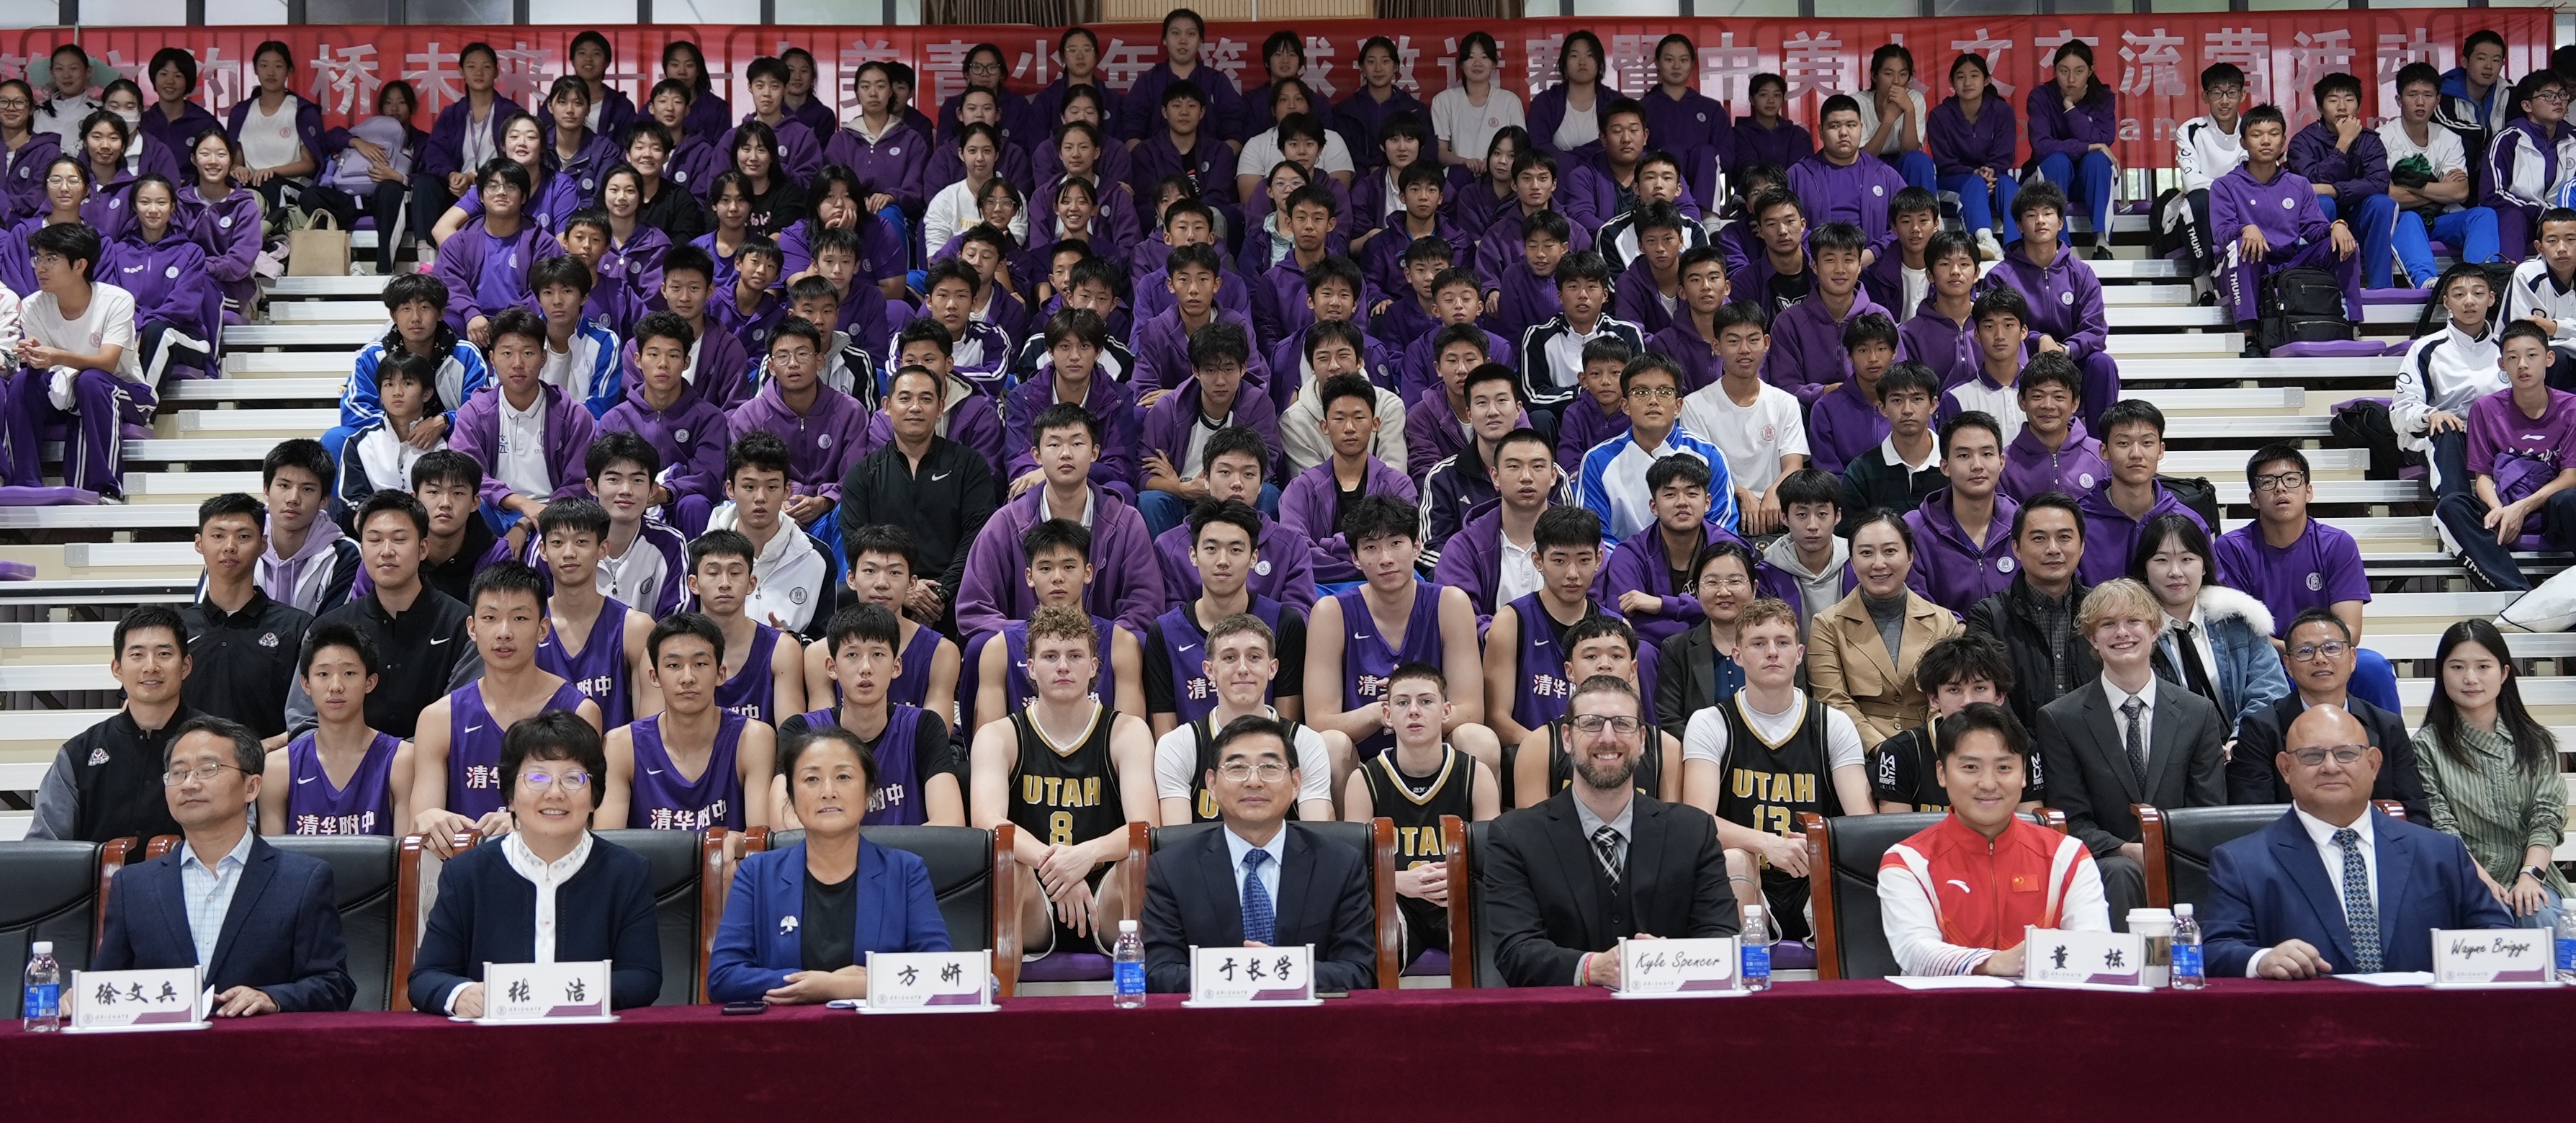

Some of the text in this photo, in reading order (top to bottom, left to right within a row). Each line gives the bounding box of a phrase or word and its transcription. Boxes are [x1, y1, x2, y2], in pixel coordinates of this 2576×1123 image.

[2187, 226, 2204, 259] THUHS
[2229, 271, 2241, 305] THUHS
[1023, 774, 1100, 807] UTAH
[1732, 768, 1816, 802] UTAH
[295, 810, 375, 836] 清华附中
[650, 799, 727, 831] 清华附中
[1049, 811, 1073, 846] 8
[1753, 804, 1791, 838] 13
[1635, 952, 1666, 975] Kyle
[1671, 952, 1721, 973] Spencer
[2451, 937, 2531, 959] Wayne Briggs
[1219, 955, 1293, 981] 于长学
[95, 981, 178, 1006] 徐文兵
